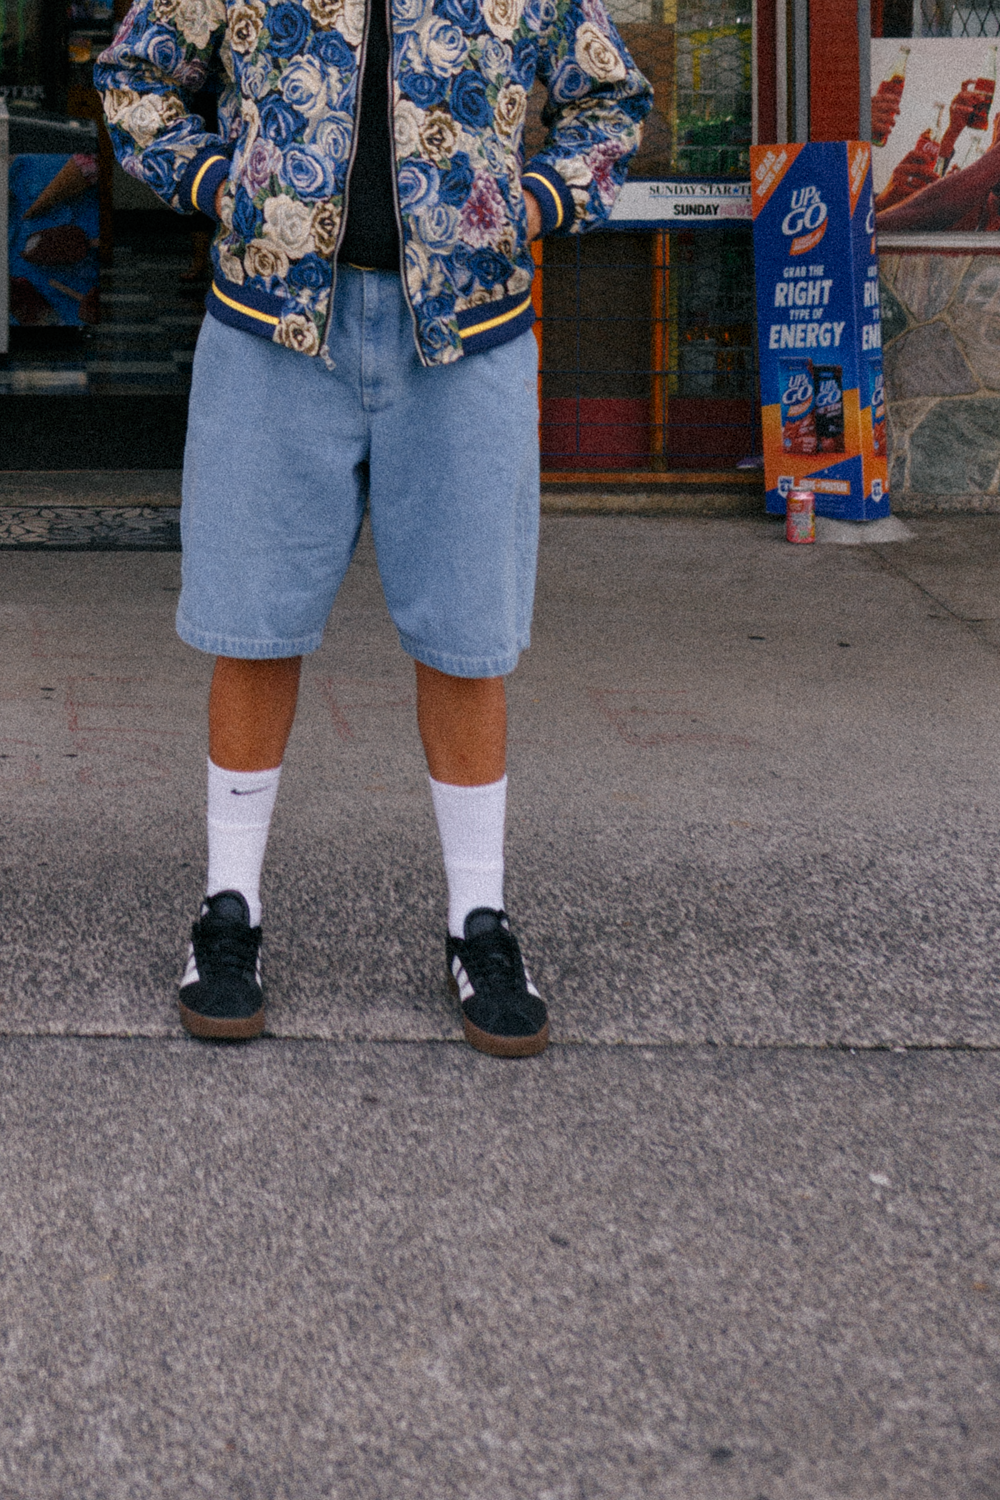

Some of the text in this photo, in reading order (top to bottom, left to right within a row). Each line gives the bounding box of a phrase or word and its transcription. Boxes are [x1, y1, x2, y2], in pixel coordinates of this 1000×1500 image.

[650, 185, 696, 195] SUNDAY
[673, 204, 719, 216] SUNDAY
[781, 202, 827, 235] GO
[783, 265, 824, 278] GRAB THE
[774, 279, 833, 307] RIGHT
[789, 307, 824, 321] TYPE OF
[768, 321, 846, 350] ENERGY
[782, 384, 813, 405] GO
[815, 388, 842, 407] GO
